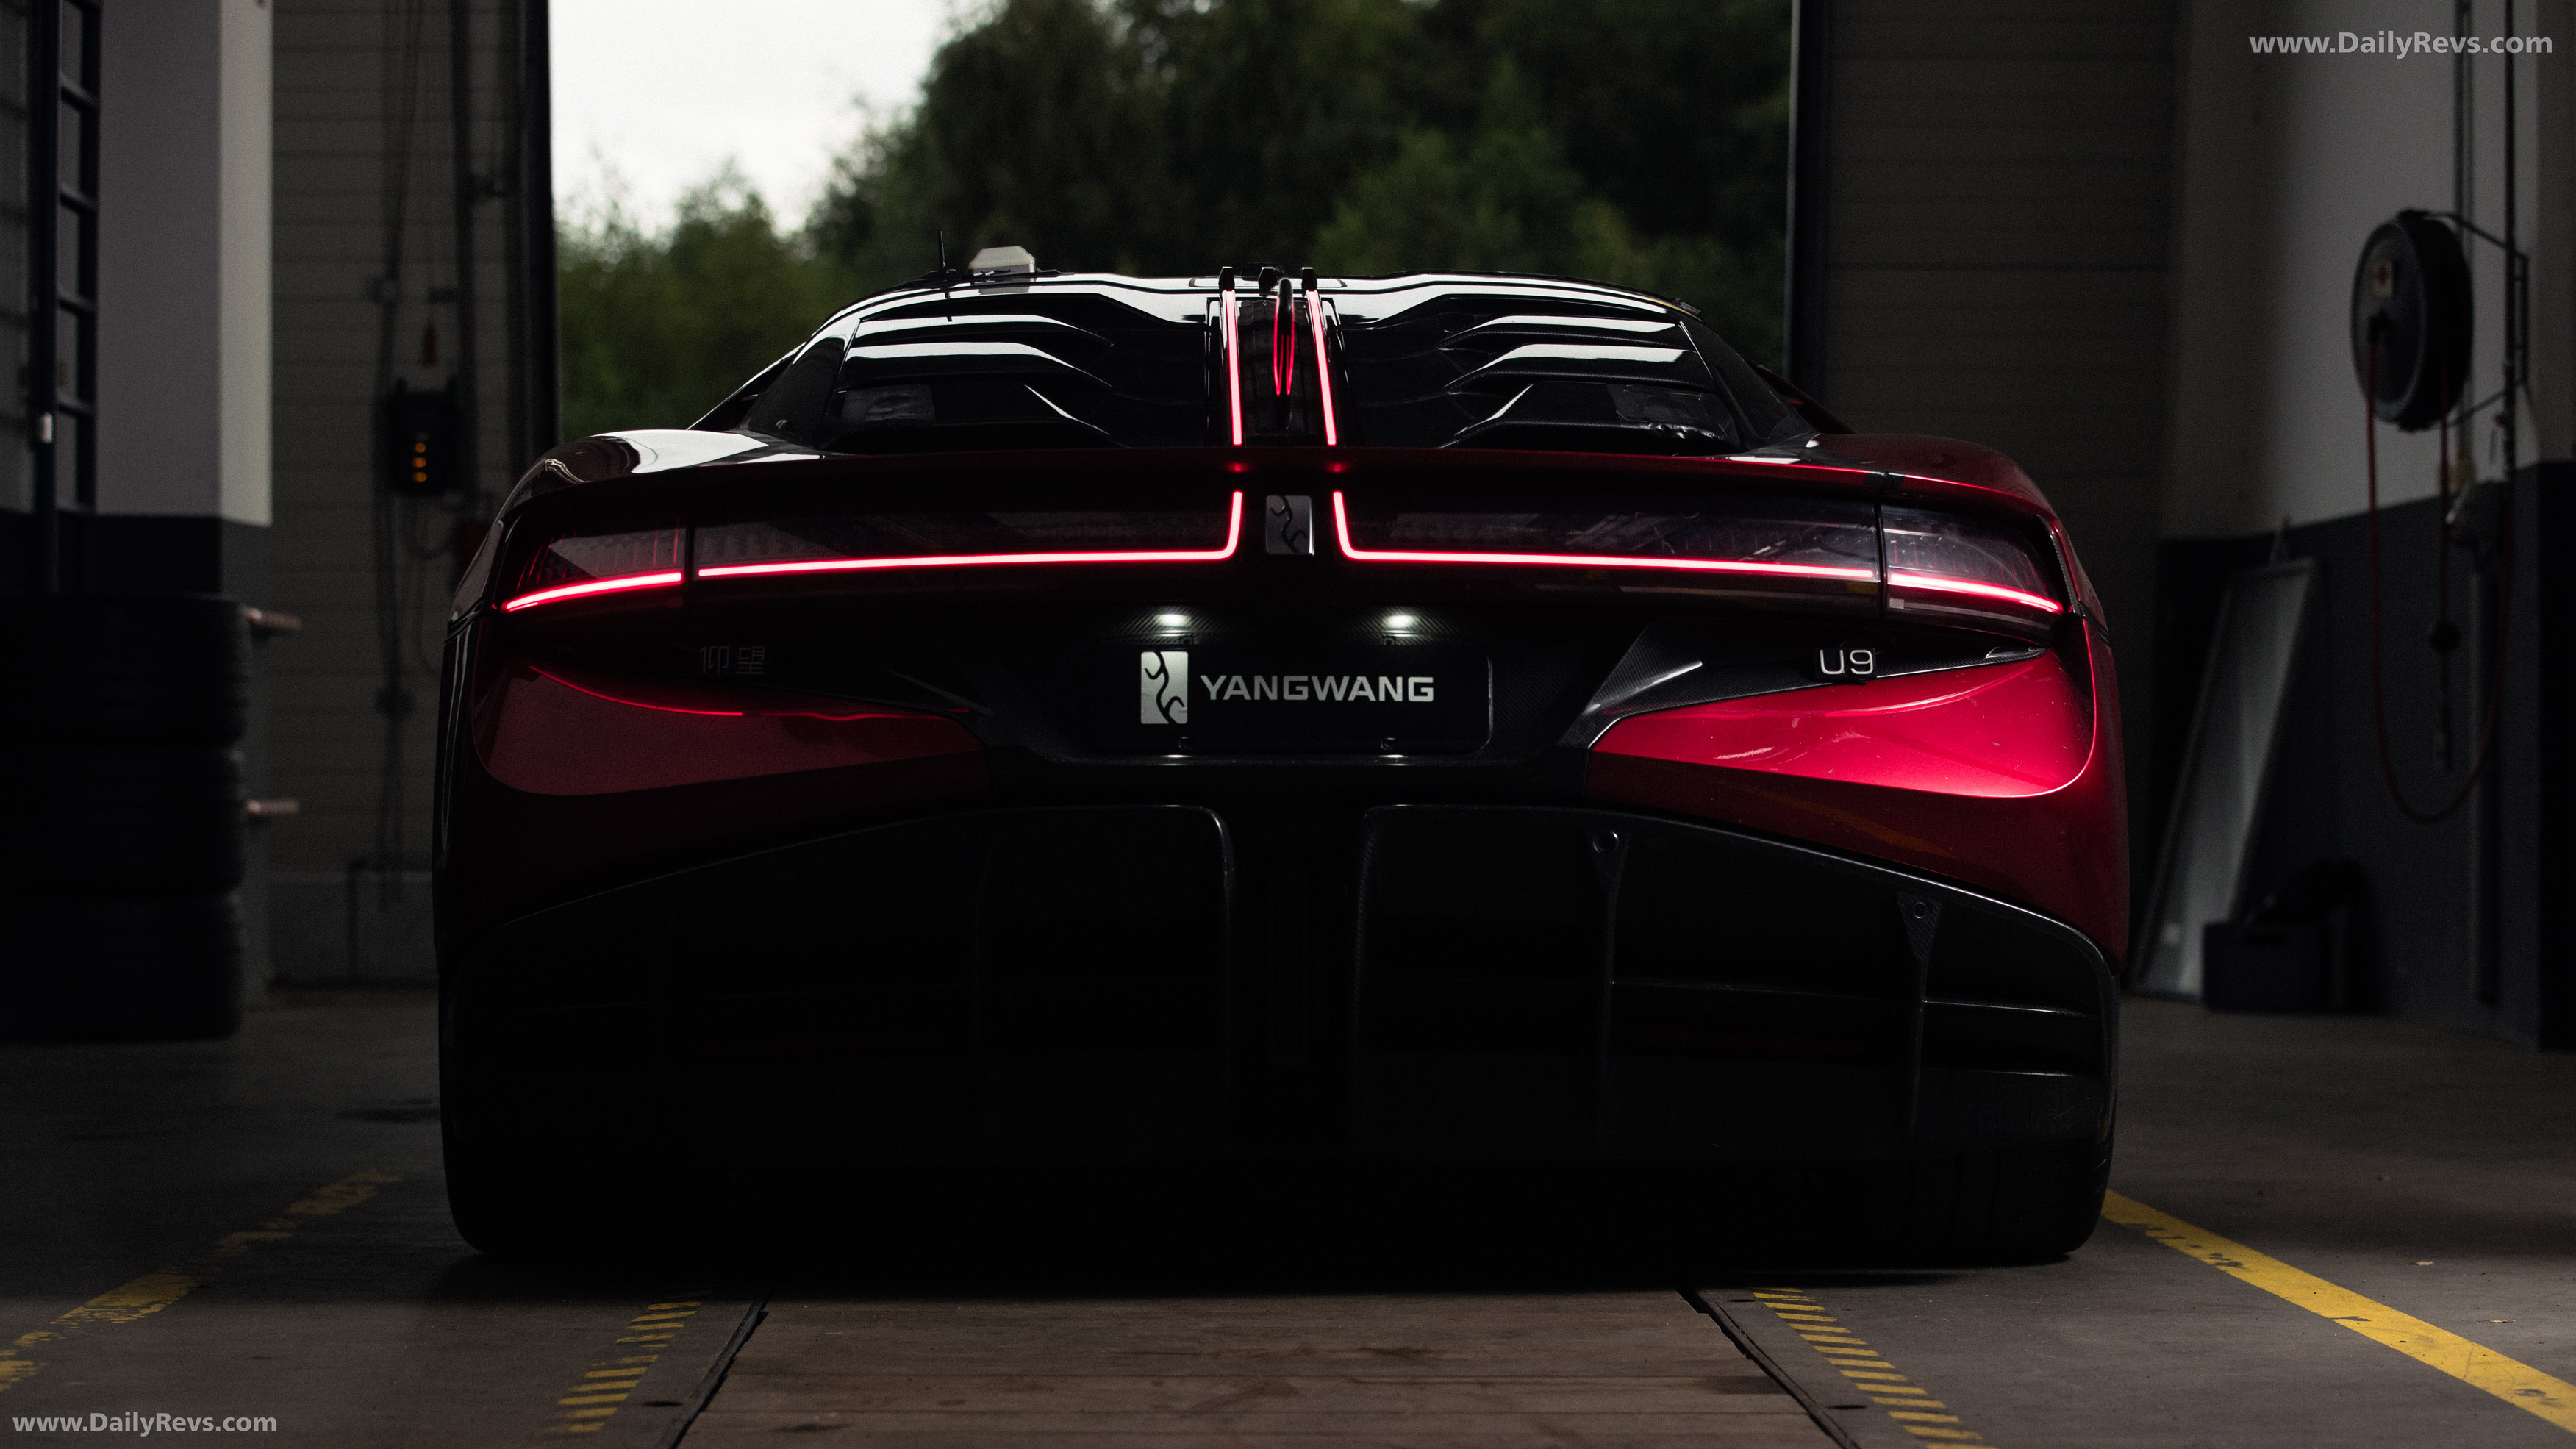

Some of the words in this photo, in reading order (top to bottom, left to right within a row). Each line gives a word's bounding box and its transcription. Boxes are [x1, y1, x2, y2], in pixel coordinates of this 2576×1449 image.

[699, 645, 765, 676] 仰望
[1817, 648, 1876, 676] U9
[1200, 675, 1434, 702] YANGWANG
